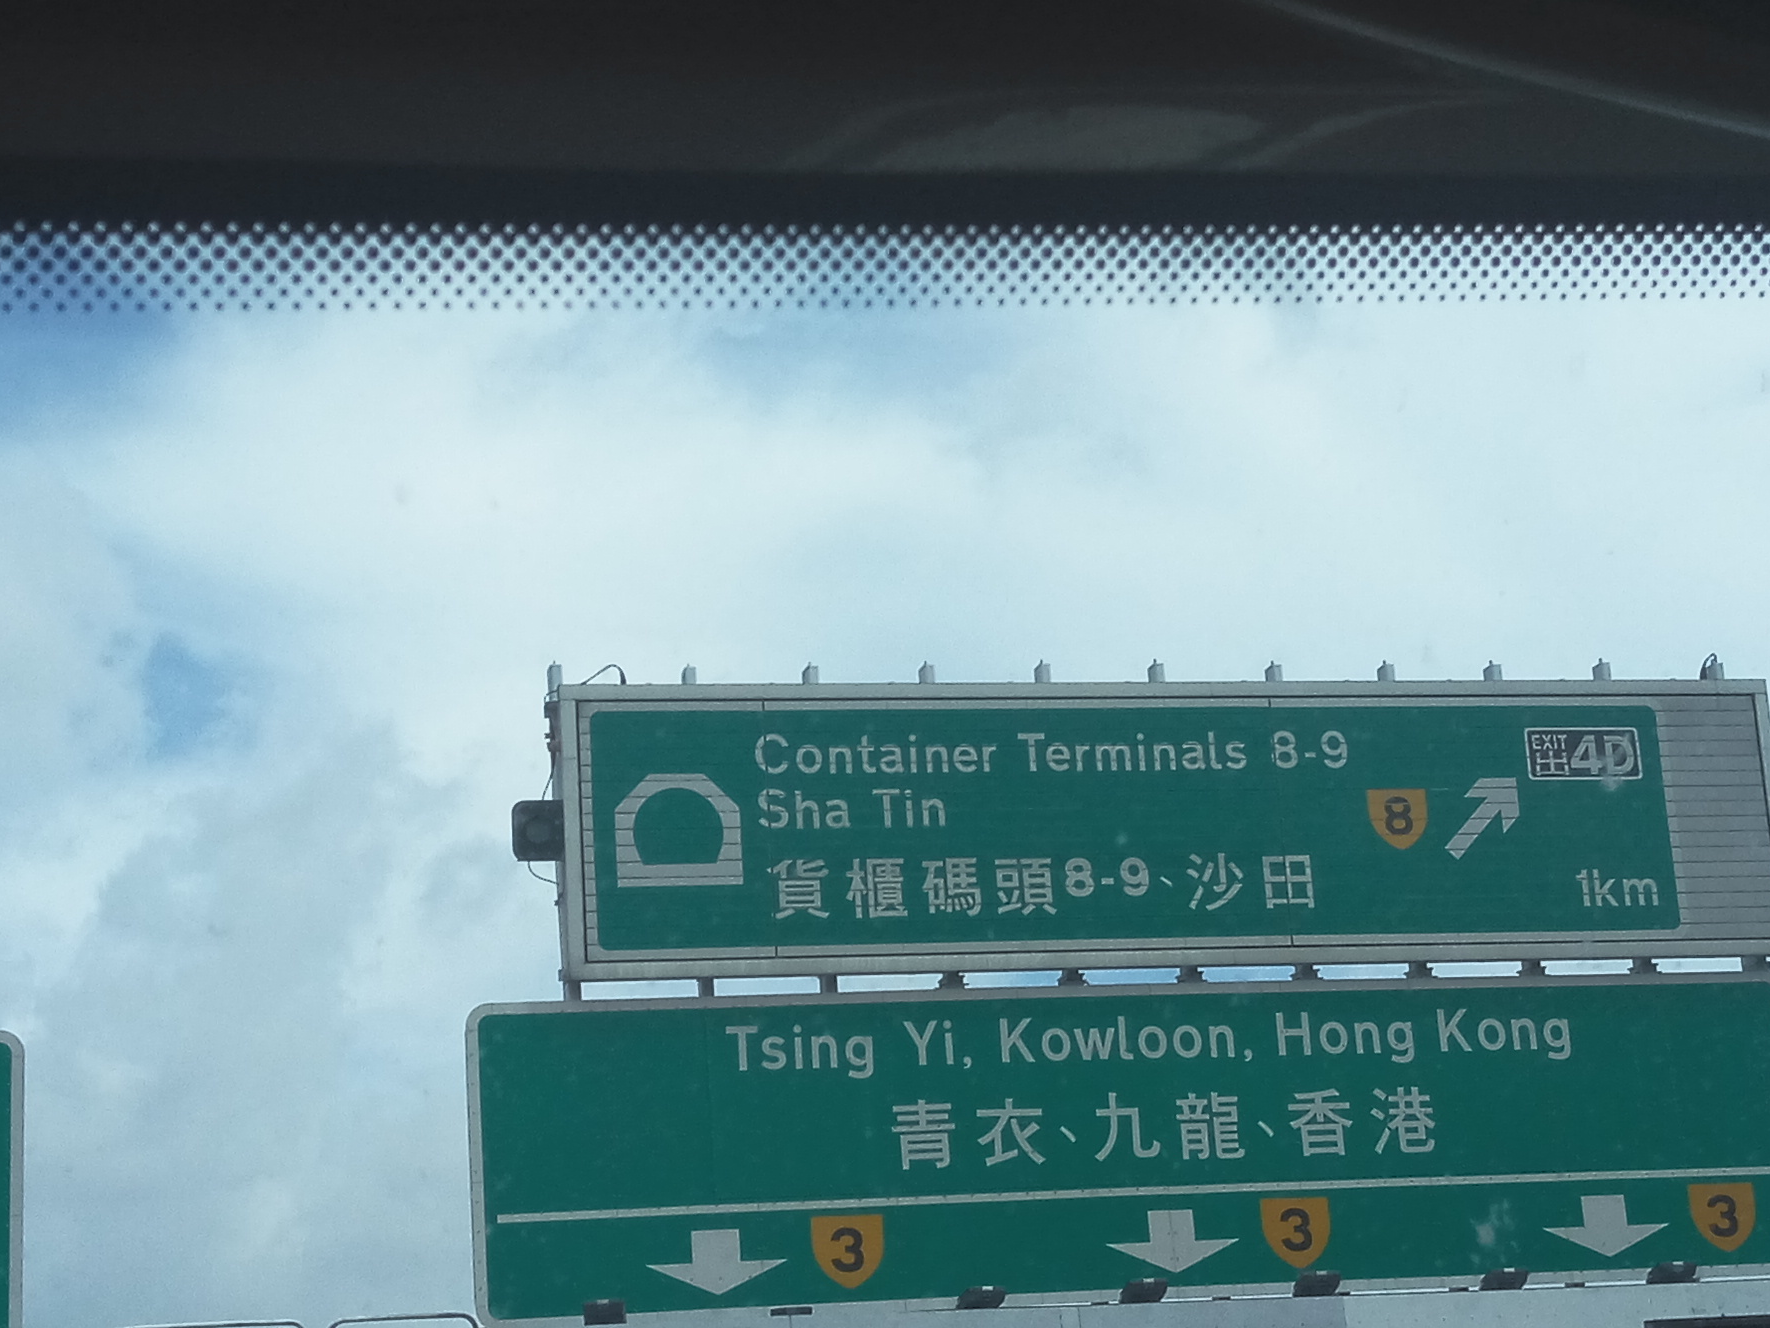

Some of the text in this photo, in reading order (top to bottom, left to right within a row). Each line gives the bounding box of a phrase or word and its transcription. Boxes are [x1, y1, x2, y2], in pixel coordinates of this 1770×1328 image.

[755, 730, 1348, 774] Container Terminals 8-9
[1531, 734, 1567, 750] EXIT
[1570, 734, 1634, 775] 4D
[1535, 750, 1569, 776] 出
[757, 788, 946, 829] Sha Tin
[1383, 796, 1414, 835] 8
[1575, 868, 1659, 907] 1km
[726, 1008, 1571, 1078] Tsing Yi, Kowloon, Hong Kong
[1279, 1208, 1313, 1252] 3
[1707, 1194, 1738, 1237] 3
[830, 1227, 865, 1273] 3
